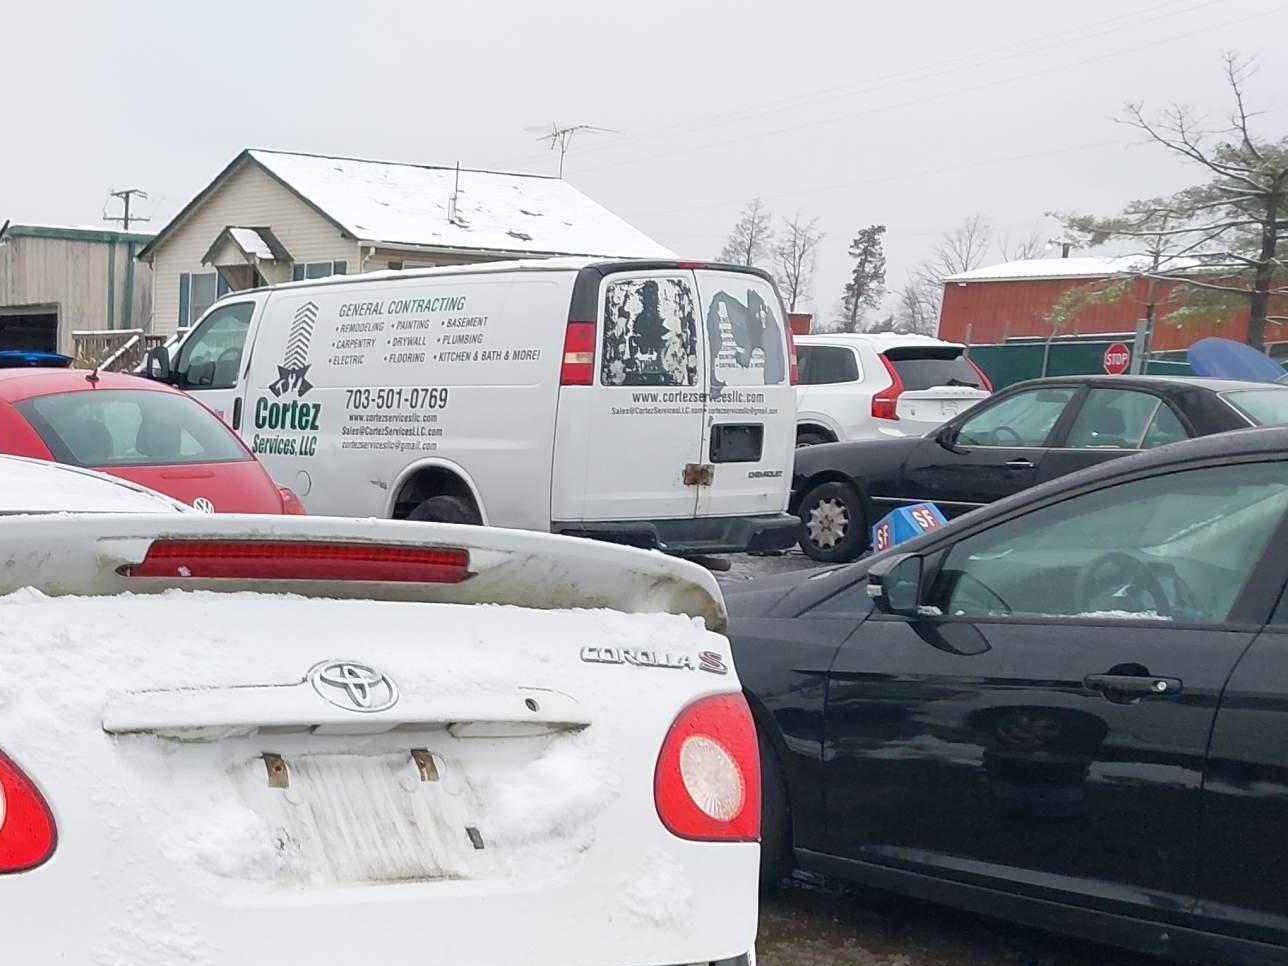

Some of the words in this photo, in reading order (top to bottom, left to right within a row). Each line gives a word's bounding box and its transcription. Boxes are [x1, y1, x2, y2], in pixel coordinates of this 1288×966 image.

[339, 302, 384, 318] GENERAL
[387, 296, 466, 315] CONTRACTING
[340, 321, 385, 333] REMODELING
[396, 319, 430, 330] PAINTING
[446, 316, 488, 328] BASEMENT
[336, 338, 376, 350] CARPENTRY
[392, 336, 427, 347] DRYWALL
[442, 334, 483, 345] PLUMBING
[333, 354, 365, 365] ELECTRIC
[388, 352, 425, 363] FLOORING
[438, 351, 472, 362] KITCHEN
[481, 350, 502, 361] BATH
[512, 349, 541, 361] MORE!
[1106, 352, 1128, 366] STOP
[345, 388, 448, 409] 703-501-0769
[255, 397, 321, 431] Cortez
[348, 413, 437, 423] www.cortezservicesllc.com
[252, 434, 297, 456] Services,
[298, 437, 318, 457] LLC
[580, 647, 696, 671] COROLLA
[698, 650, 728, 675] S
